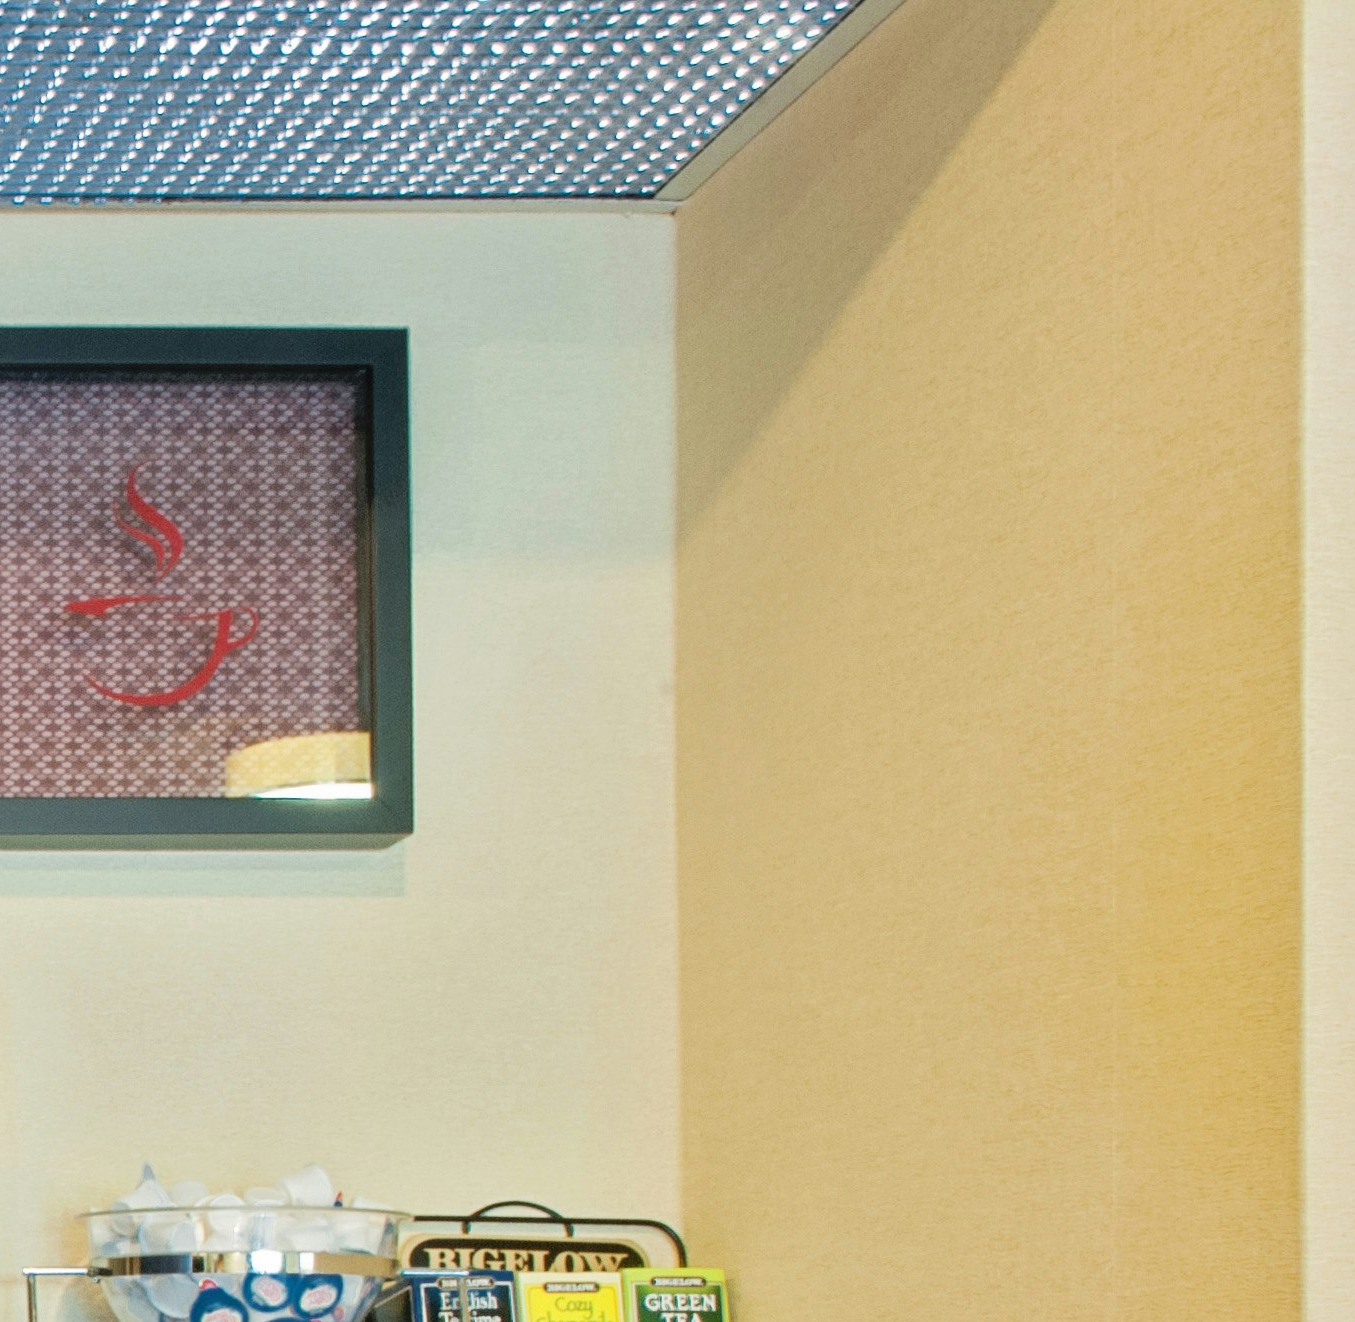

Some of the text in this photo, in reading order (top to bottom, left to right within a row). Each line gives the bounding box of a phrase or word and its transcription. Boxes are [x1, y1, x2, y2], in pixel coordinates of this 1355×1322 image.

[423, 1248, 629, 1272] BIGELOW
[439, 1290, 498, 1311] Enlish
[554, 1296, 593, 1319] Cozy
[644, 1293, 717, 1312] GREEN
